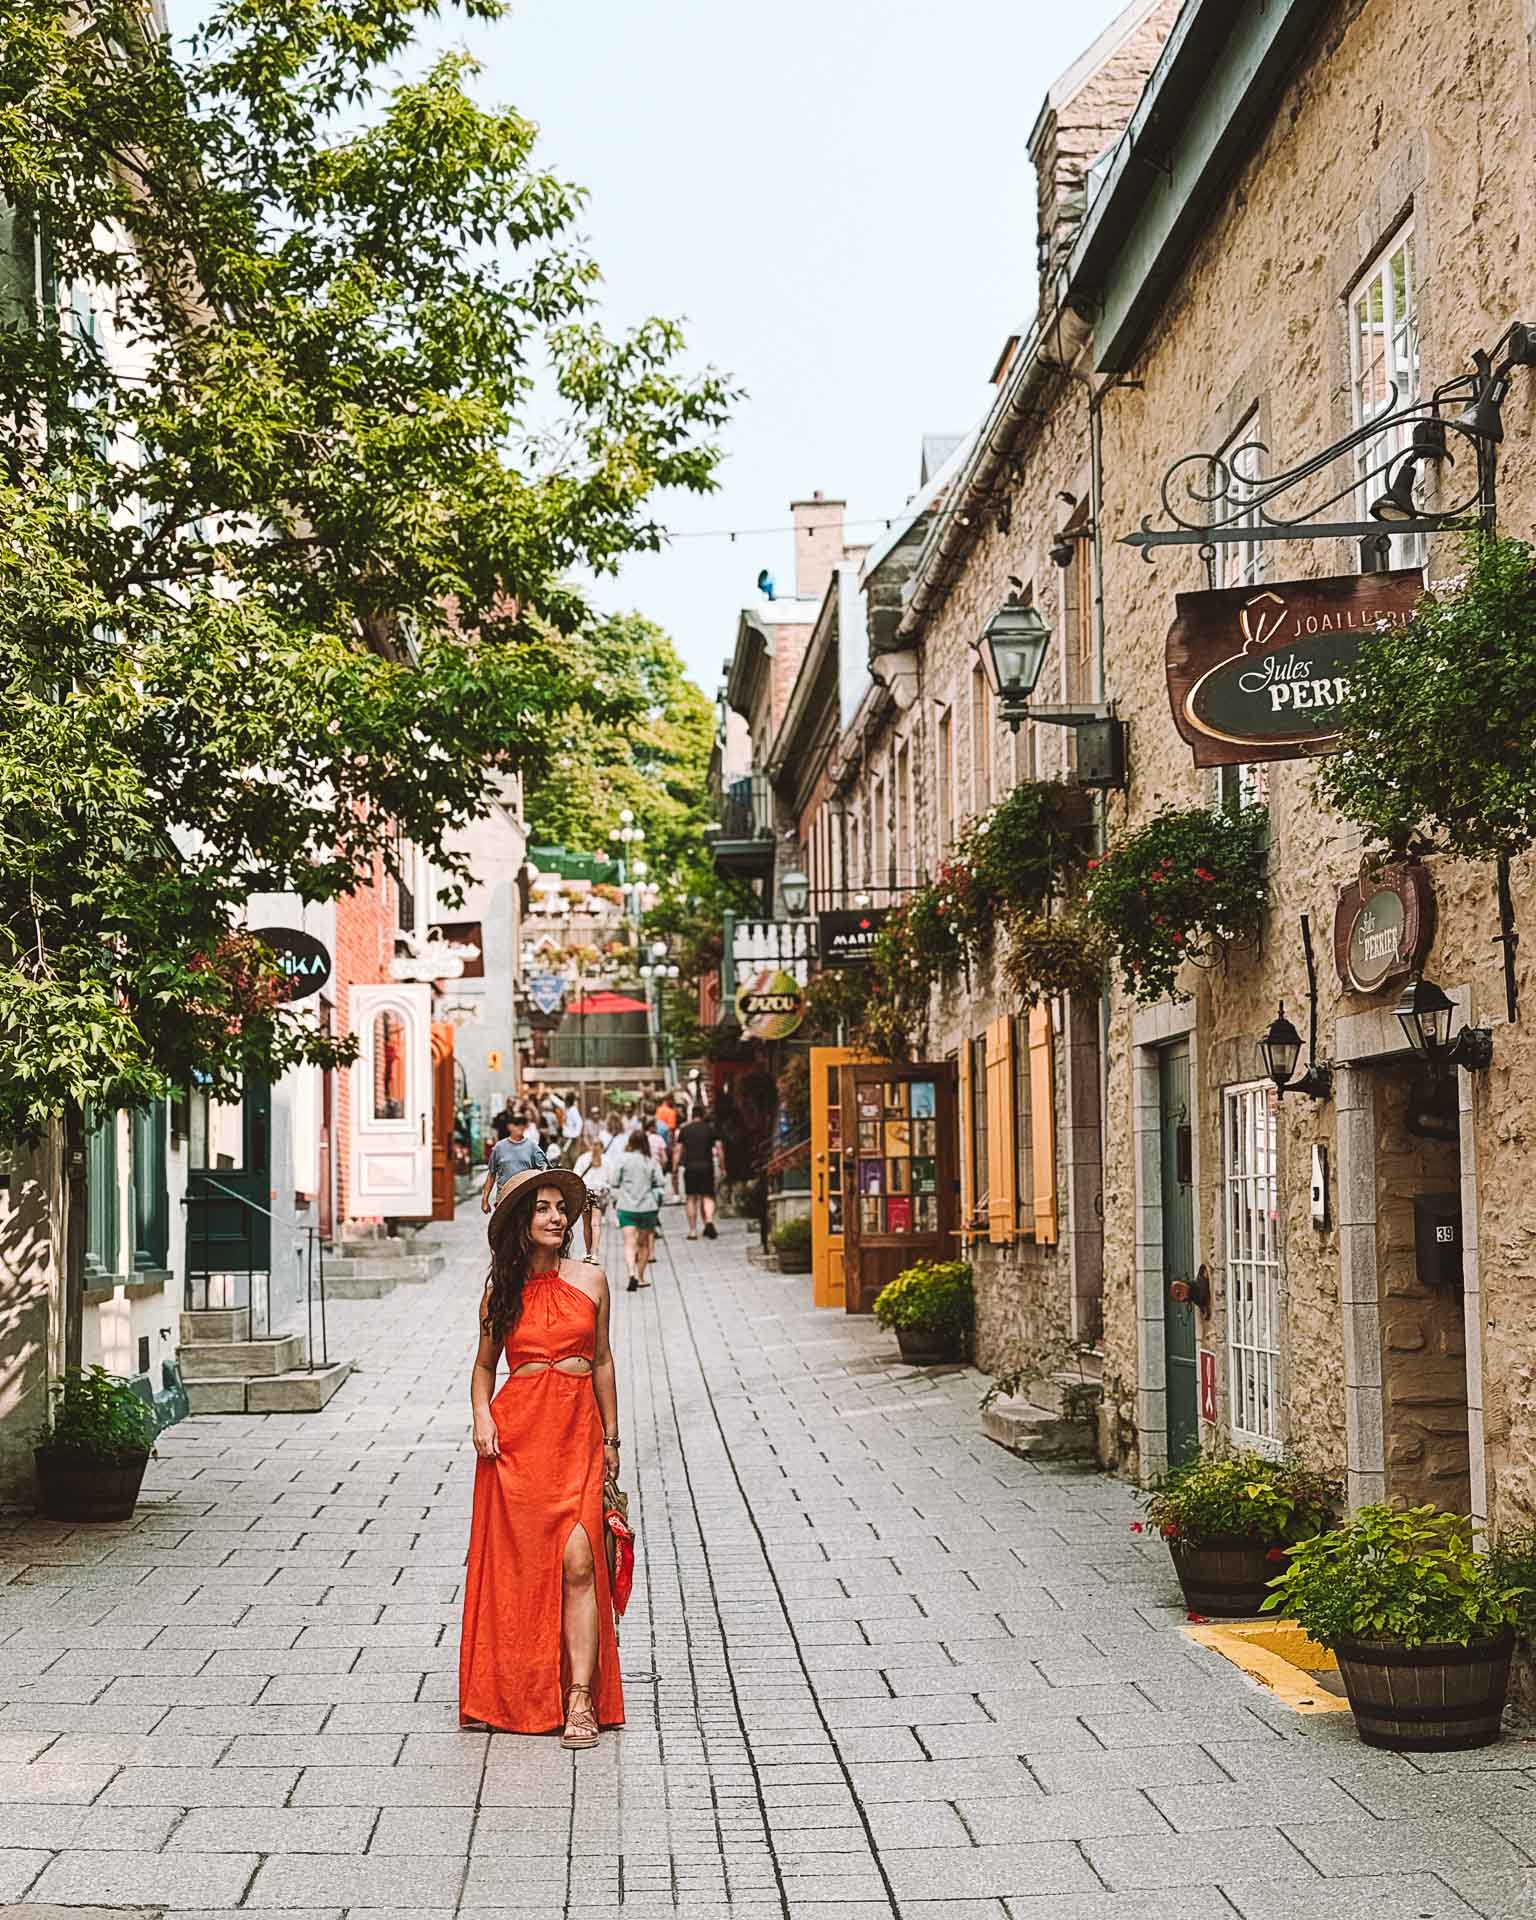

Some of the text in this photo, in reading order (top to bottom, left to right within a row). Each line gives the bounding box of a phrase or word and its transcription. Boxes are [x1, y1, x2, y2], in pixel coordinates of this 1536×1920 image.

[1293, 610, 1408, 637] JOAILLERI
[1239, 653, 1313, 693] Jules
[1268, 677, 1357, 712] PERR
[1438, 1227, 1452, 1241] 39
